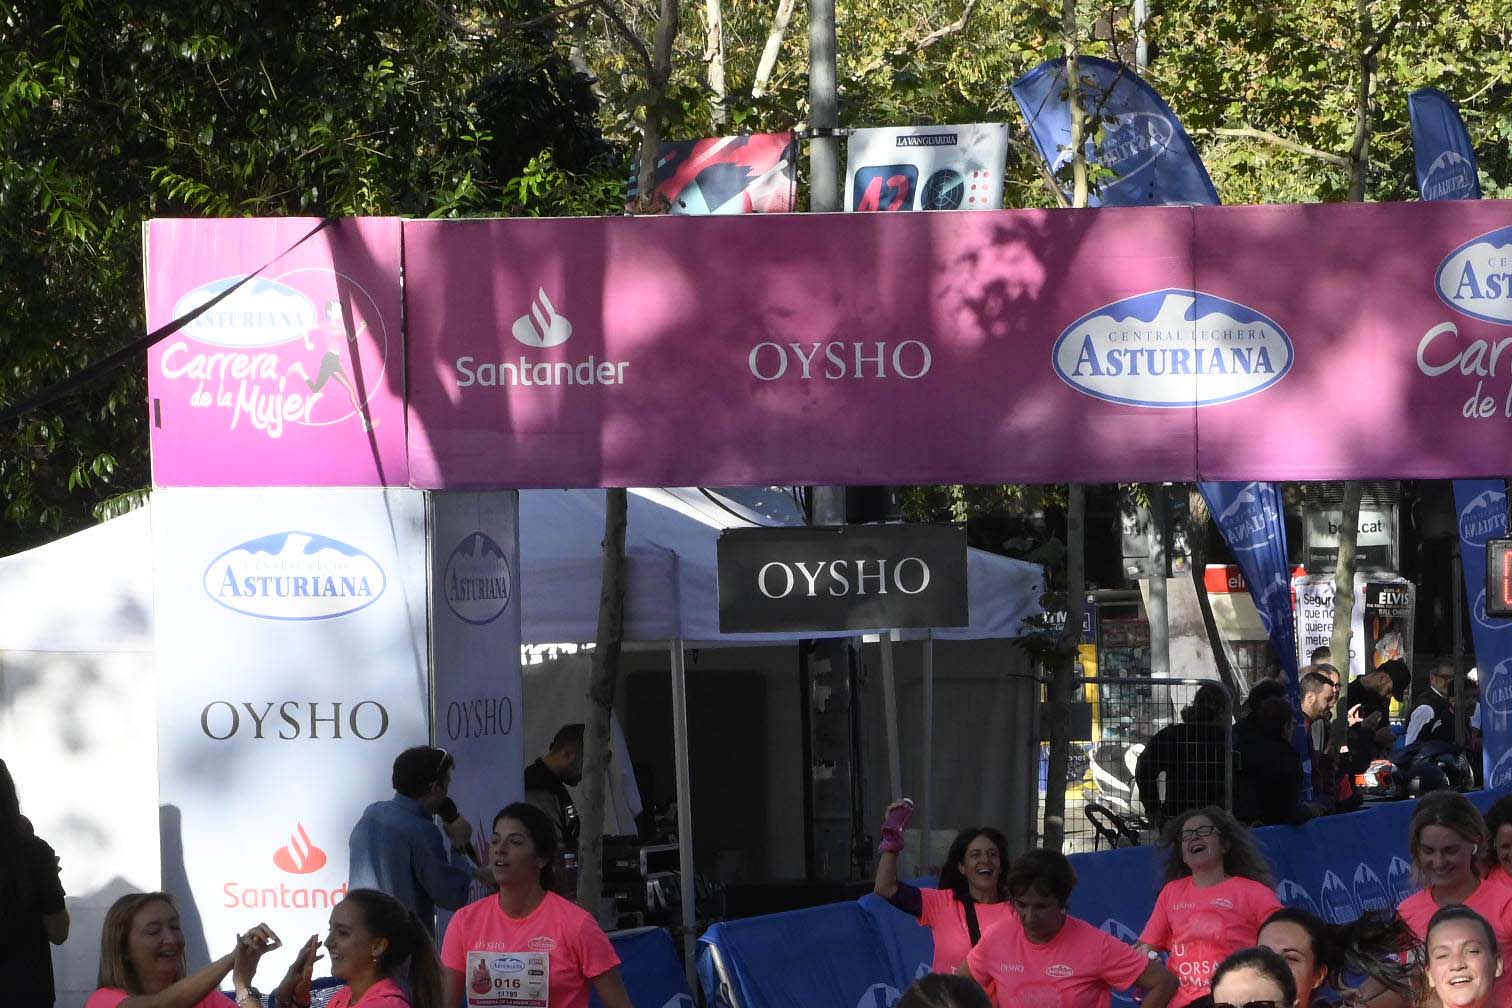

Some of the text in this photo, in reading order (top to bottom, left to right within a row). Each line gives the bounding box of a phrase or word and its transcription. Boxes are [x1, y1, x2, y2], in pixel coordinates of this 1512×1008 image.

[1108, 329, 1267, 343] CENTRAL LECHERA
[161, 342, 279, 380] Carrera
[456, 356, 630, 387] Santander
[748, 340, 934, 382] OYSHO
[1072, 335, 1275, 377] ASTURIANA
[190, 376, 325, 439] de la Mujer
[1462, 380, 1496, 418] de
[1328, 520, 1382, 535] b.cat
[218, 565, 373, 599] ASTURIANA
[450, 573, 508, 602] ASTURIANA
[758, 557, 931, 599] OYSHO
[1379, 592, 1410, 605] ELVIS
[201, 700, 390, 741] OYSHO
[447, 696, 513, 741] OYSHO
[494, 978, 521, 989] 016
